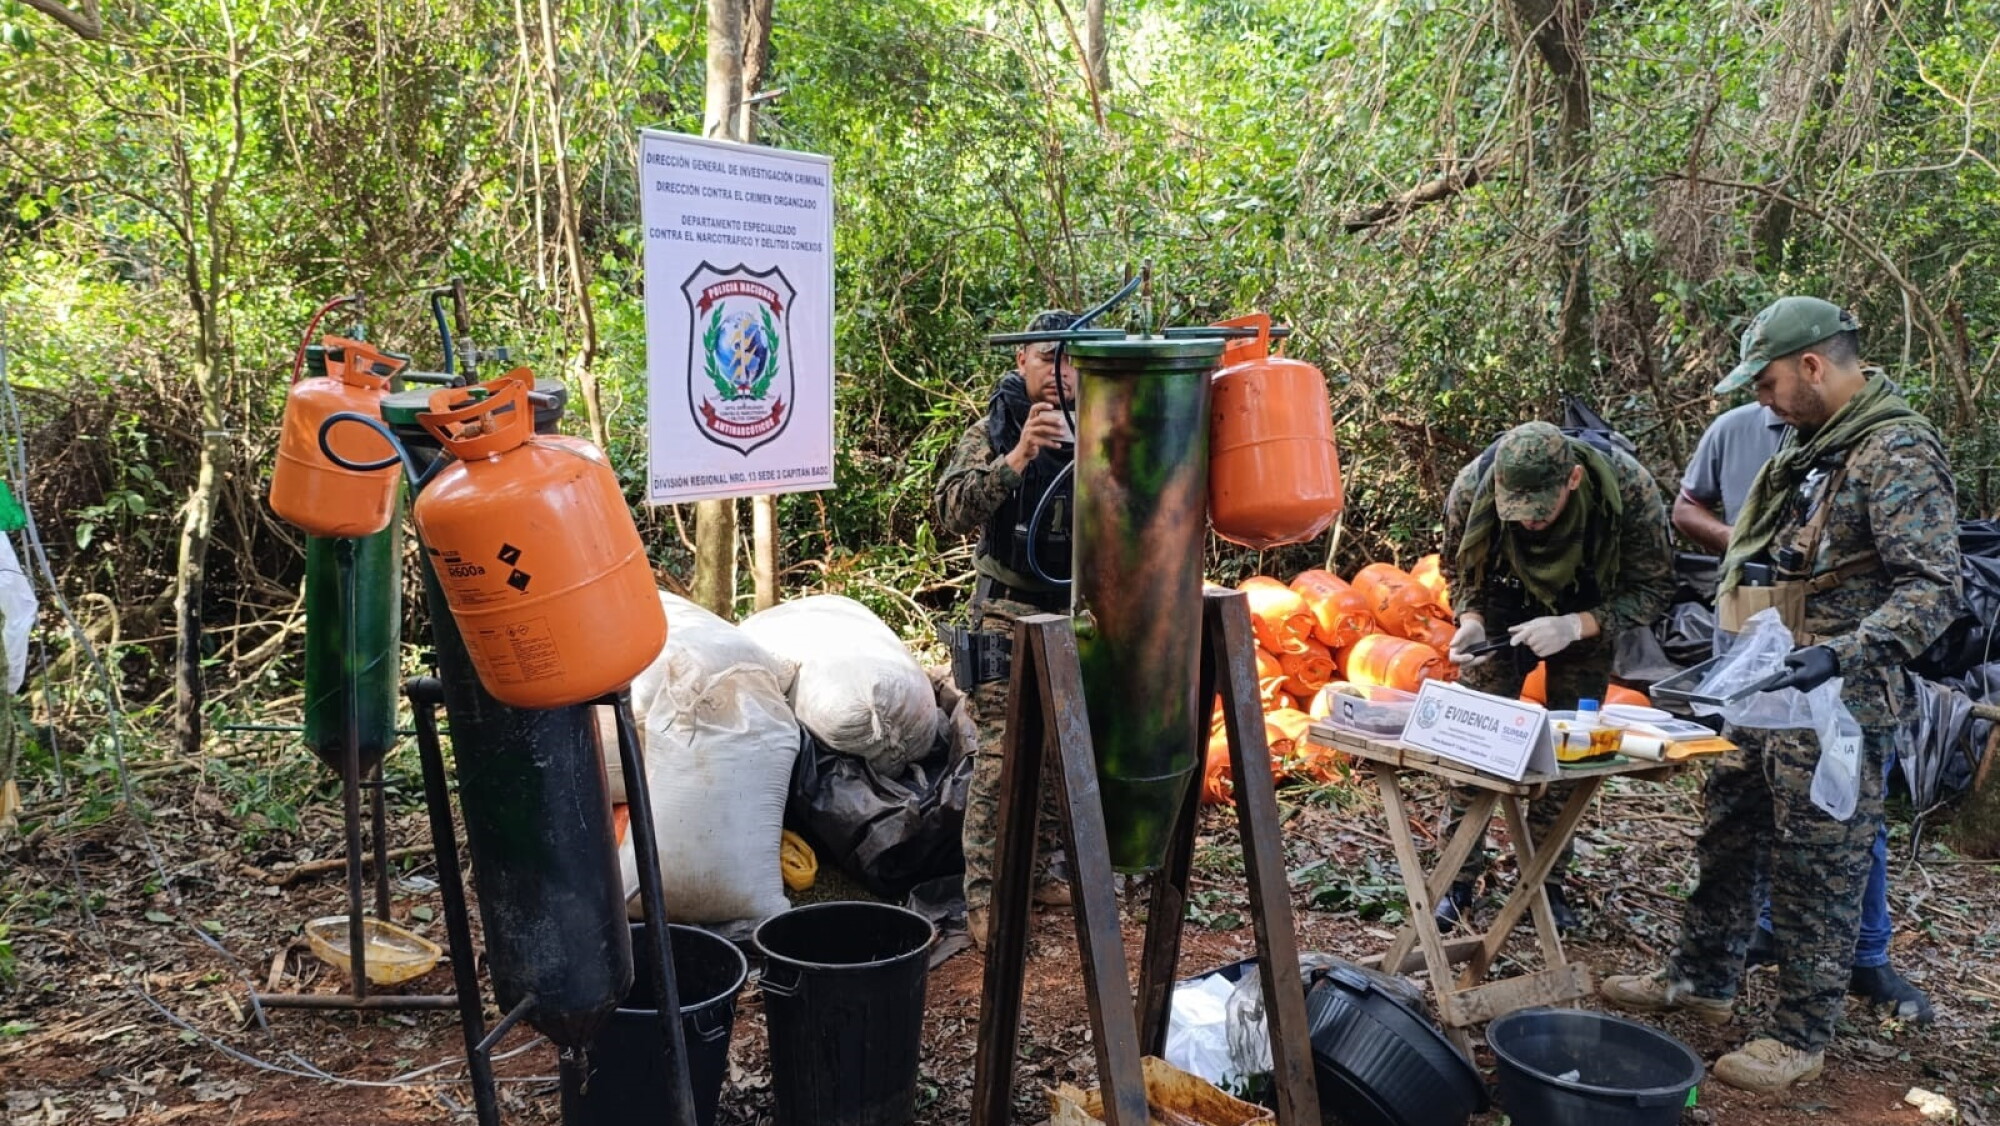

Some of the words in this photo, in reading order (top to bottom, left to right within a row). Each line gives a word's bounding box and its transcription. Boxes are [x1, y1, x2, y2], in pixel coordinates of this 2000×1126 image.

[646, 152, 690, 169] DIRECCIÓN
[692, 158, 726, 175] GENERAL
[728, 164, 738, 176] DE
[739, 165, 793, 183] INVESTIGACIÓN
[794, 174, 825, 187] CRIMINAL
[702, 187, 733, 200] CONTRA
[734, 190, 743, 201] EL
[744, 192, 772, 204] CRIMEN
[774, 195, 817, 210] ORGANIZADO
[681, 214, 741, 231] DEPARTAMENTO
[743, 221, 797, 236] ESPECIALIZADO
[649, 228, 682, 241] CONTRA
[684, 230, 694, 242] EL
[755, 238, 760, 247] Y
[761, 238, 790, 250] DELITOS
[791, 240, 823, 252] CONEXOS
[739, 281, 776, 303] NACIONAL
[690, 473, 728, 487] REGIONAL
[758, 470, 775, 481] SEDE
[811, 465, 829, 477] BADO
[448, 565, 486, 578] R600a
[1444, 705, 1500, 734] EVIDENCIA
